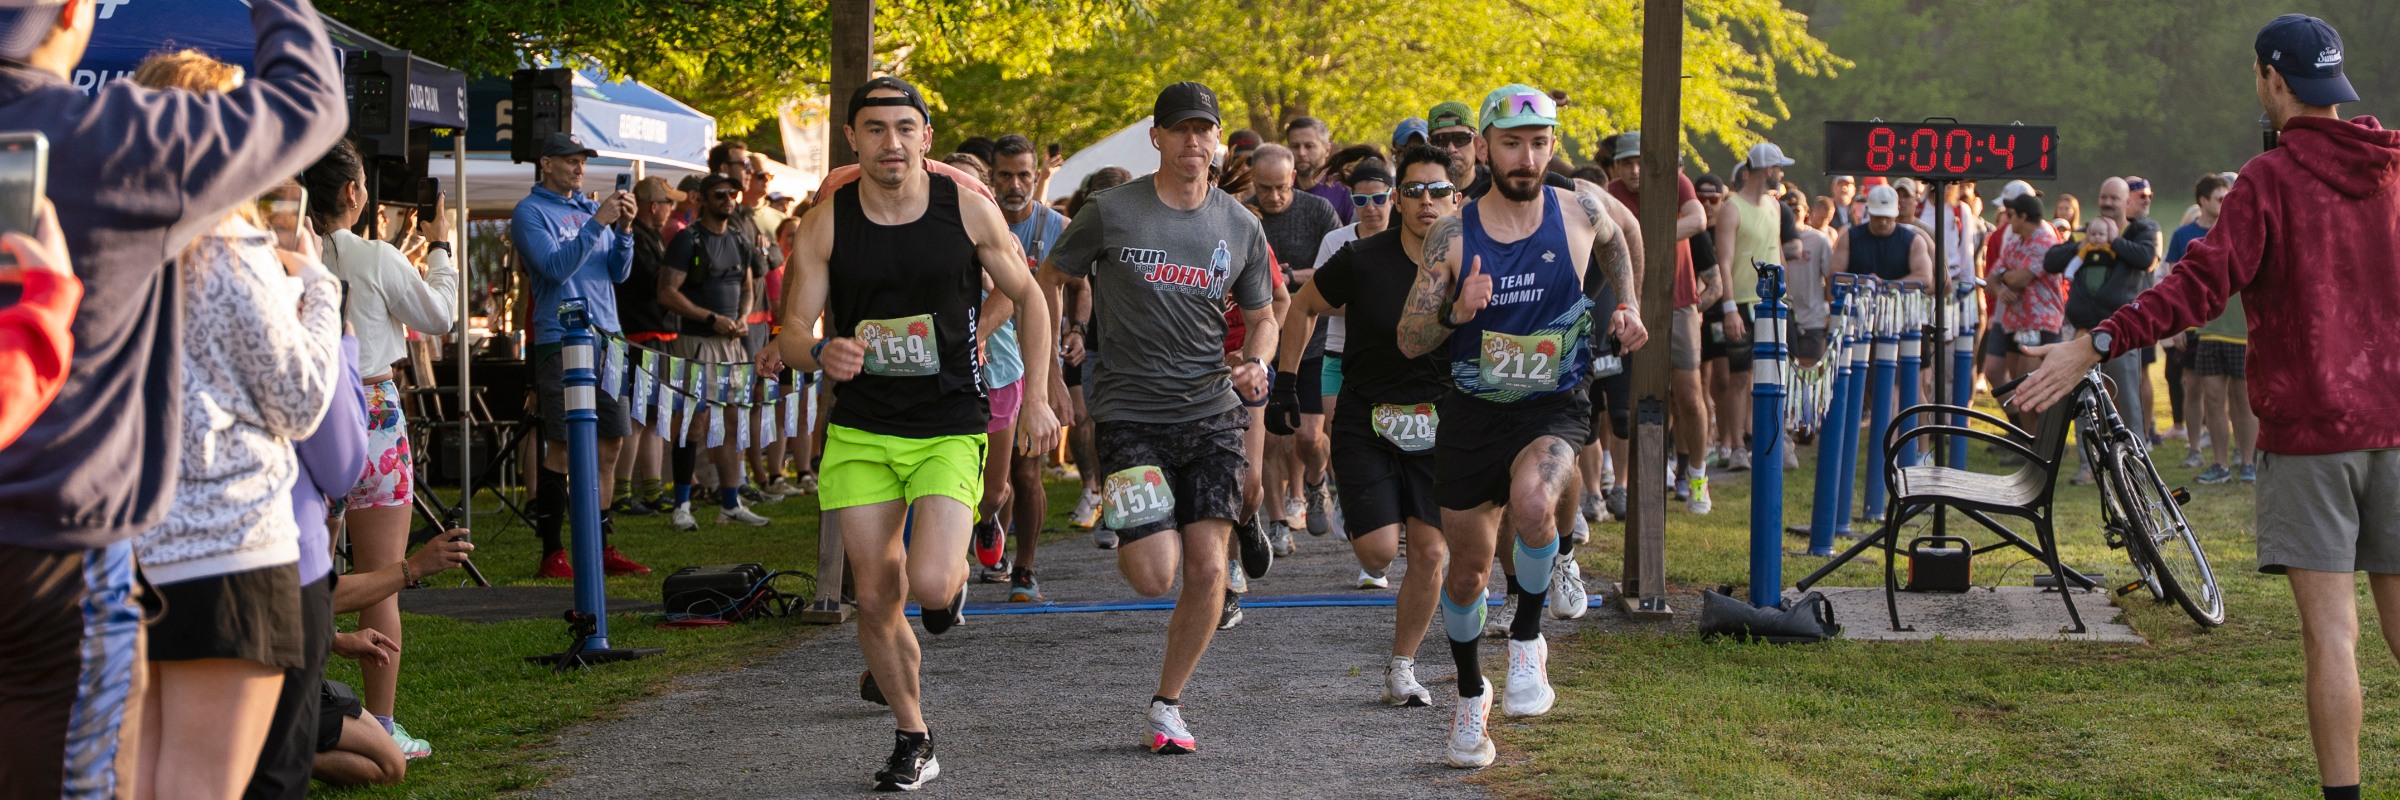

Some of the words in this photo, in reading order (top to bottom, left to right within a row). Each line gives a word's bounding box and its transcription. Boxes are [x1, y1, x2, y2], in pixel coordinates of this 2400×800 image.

[409, 83, 426, 110] OUR
[1866, 127, 2050, 172] 8:00:41
[1120, 247, 1167, 264] run
[1134, 263, 1156, 273] FOR
[1144, 263, 1212, 290] JOHN
[1500, 272, 1536, 290] TEAM
[1490, 288, 1544, 306] SUMMIT
[871, 334, 925, 364] 159
[1491, 350, 1548, 380] 212
[1382, 413, 1431, 441] 228
[1111, 481, 1163, 519] 151
